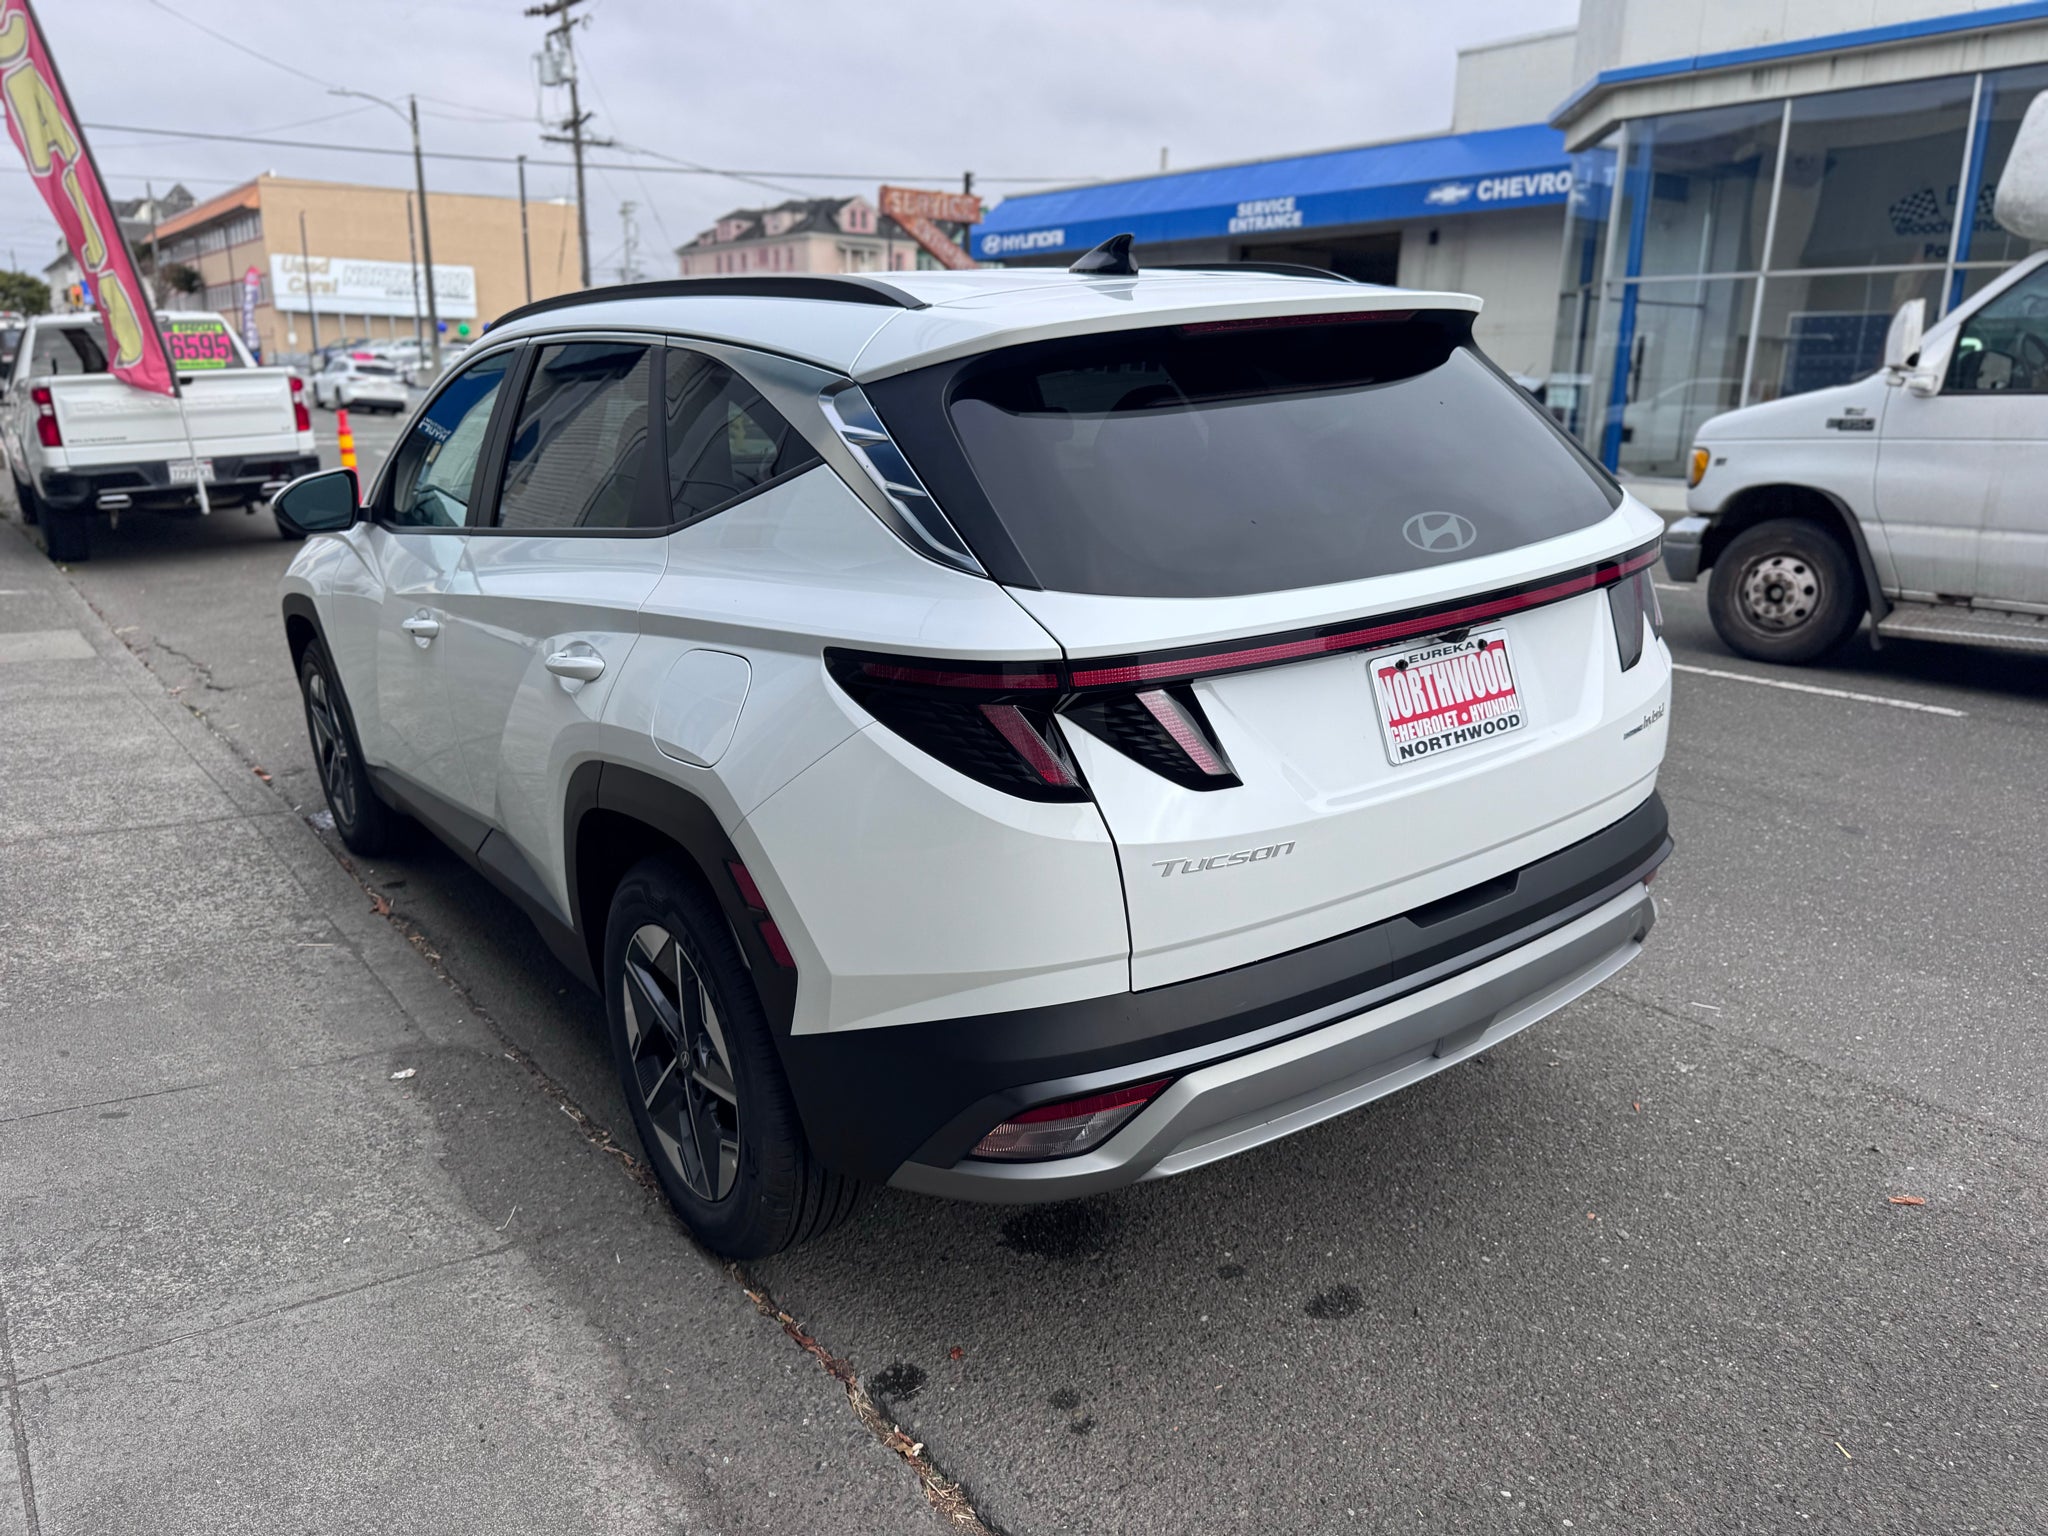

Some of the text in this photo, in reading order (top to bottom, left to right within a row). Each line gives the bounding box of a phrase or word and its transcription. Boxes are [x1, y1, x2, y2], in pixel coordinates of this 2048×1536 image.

[1228, 210, 1303, 234] ENTRANCE
[1236, 196, 1296, 217] SERVICE
[1408, 641, 1476, 664] EUREKA
[1378, 648, 1513, 722] NORTHWOOD
[1391, 694, 1522, 743] CHEVROLET HYUNDAI
[1399, 714, 1521, 760] NORTHWOOD
